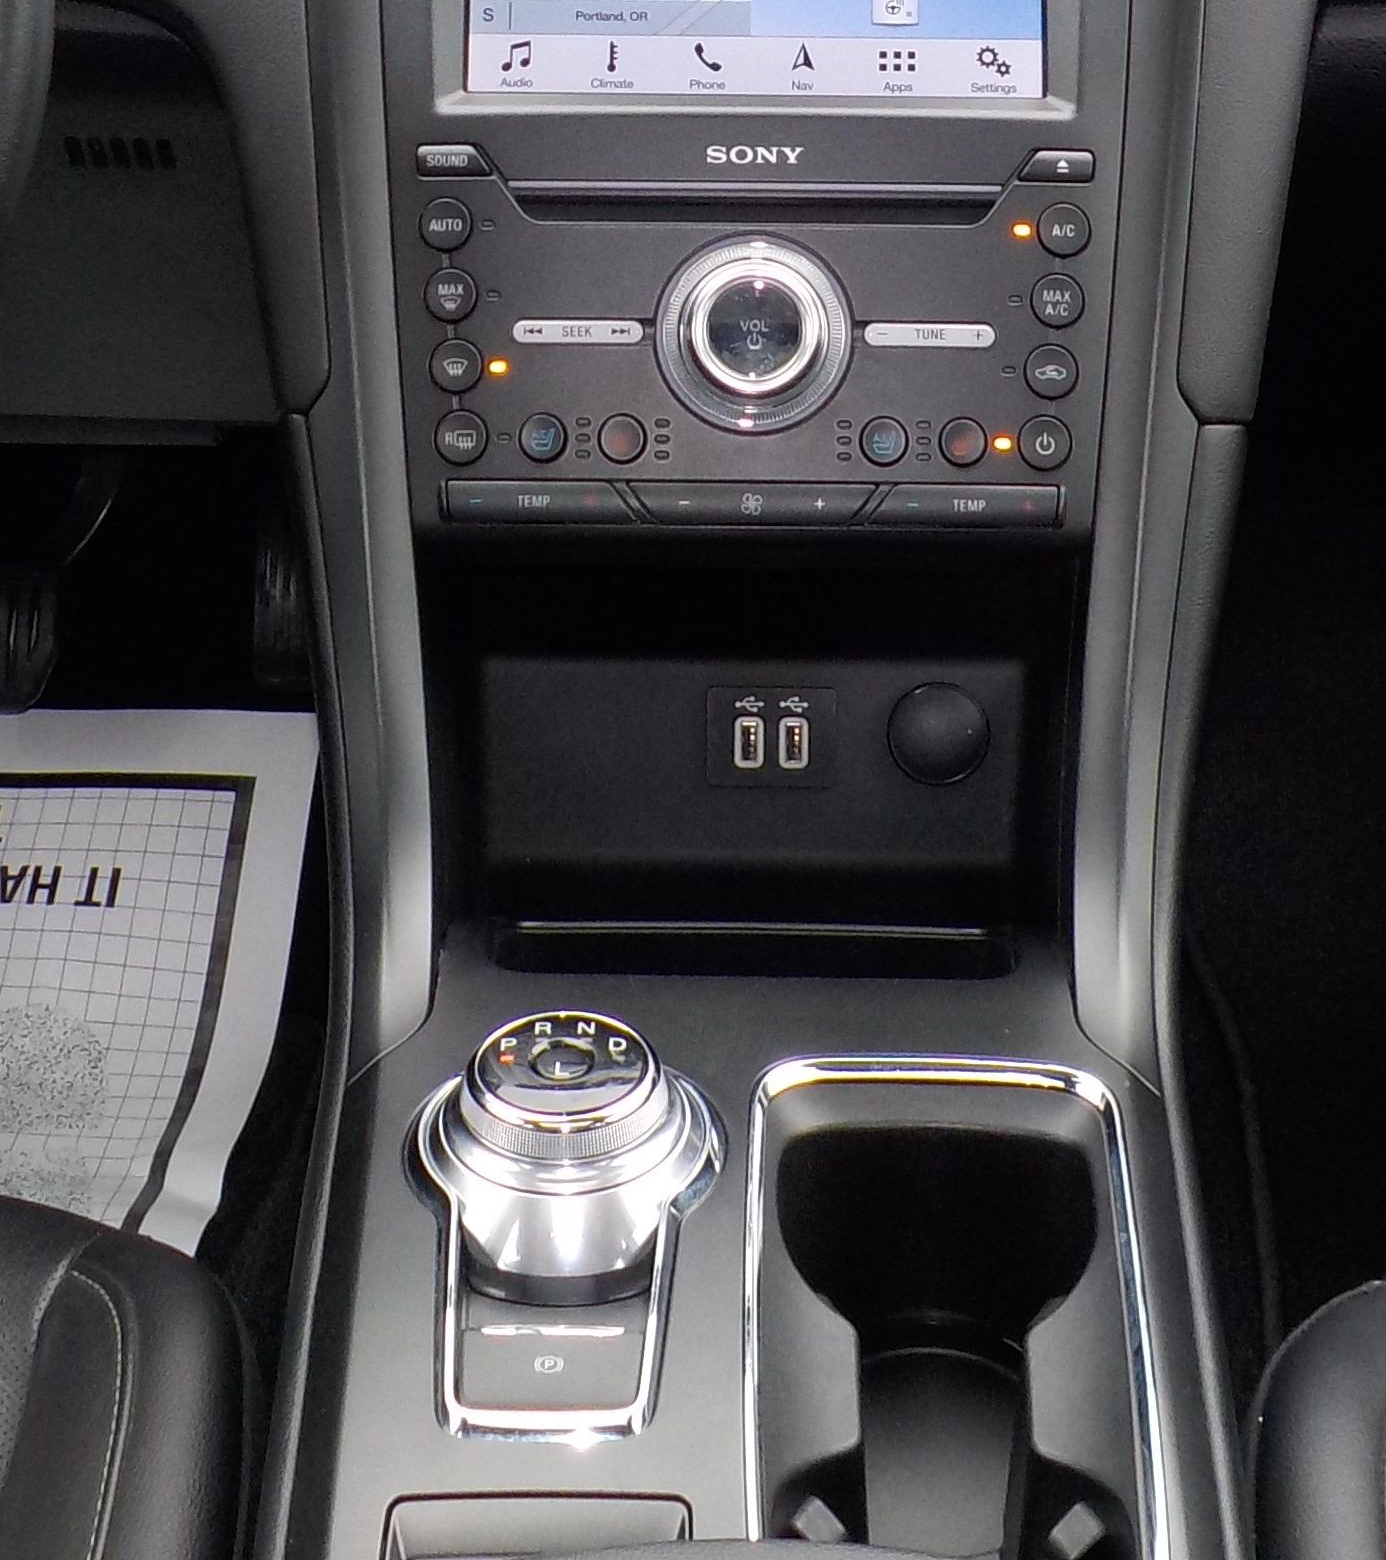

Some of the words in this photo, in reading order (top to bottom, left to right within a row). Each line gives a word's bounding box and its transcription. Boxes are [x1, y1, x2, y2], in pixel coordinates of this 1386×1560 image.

[482, 7, 495, 23] S
[575, 10, 627, 23] Portland,
[629, 10, 649, 22] OR
[499, 77, 533, 88] Audio
[590, 77, 634, 89] Climate
[689, 78, 726, 90] Phone
[791, 80, 814, 91] Nav
[883, 81, 913, 93] Apps
[970, 81, 1017, 95] Settings
[426, 154, 468, 167] SOUND
[706, 145, 804, 164] SONY
[428, 218, 463, 232] AUTO
[1051, 223, 1076, 238] A/C
[437, 284, 464, 296] MAX
[1042, 290, 1071, 303] MAX
[1044, 303, 1069, 317] A/C
[562, 325, 593, 337] SEEK
[739, 320, 770, 333] VOL
[915, 328, 946, 341] TUNE
[517, 495, 550, 509] TEMP
[952, 499, 986, 513] TEMP
[73, 867, 123, 908] IT
[534, 1021, 552, 1035] R
[576, 1021, 596, 1035] N
[500, 1037, 518, 1051] P
[608, 1037, 627, 1051] D
[554, 1061, 570, 1077] L
